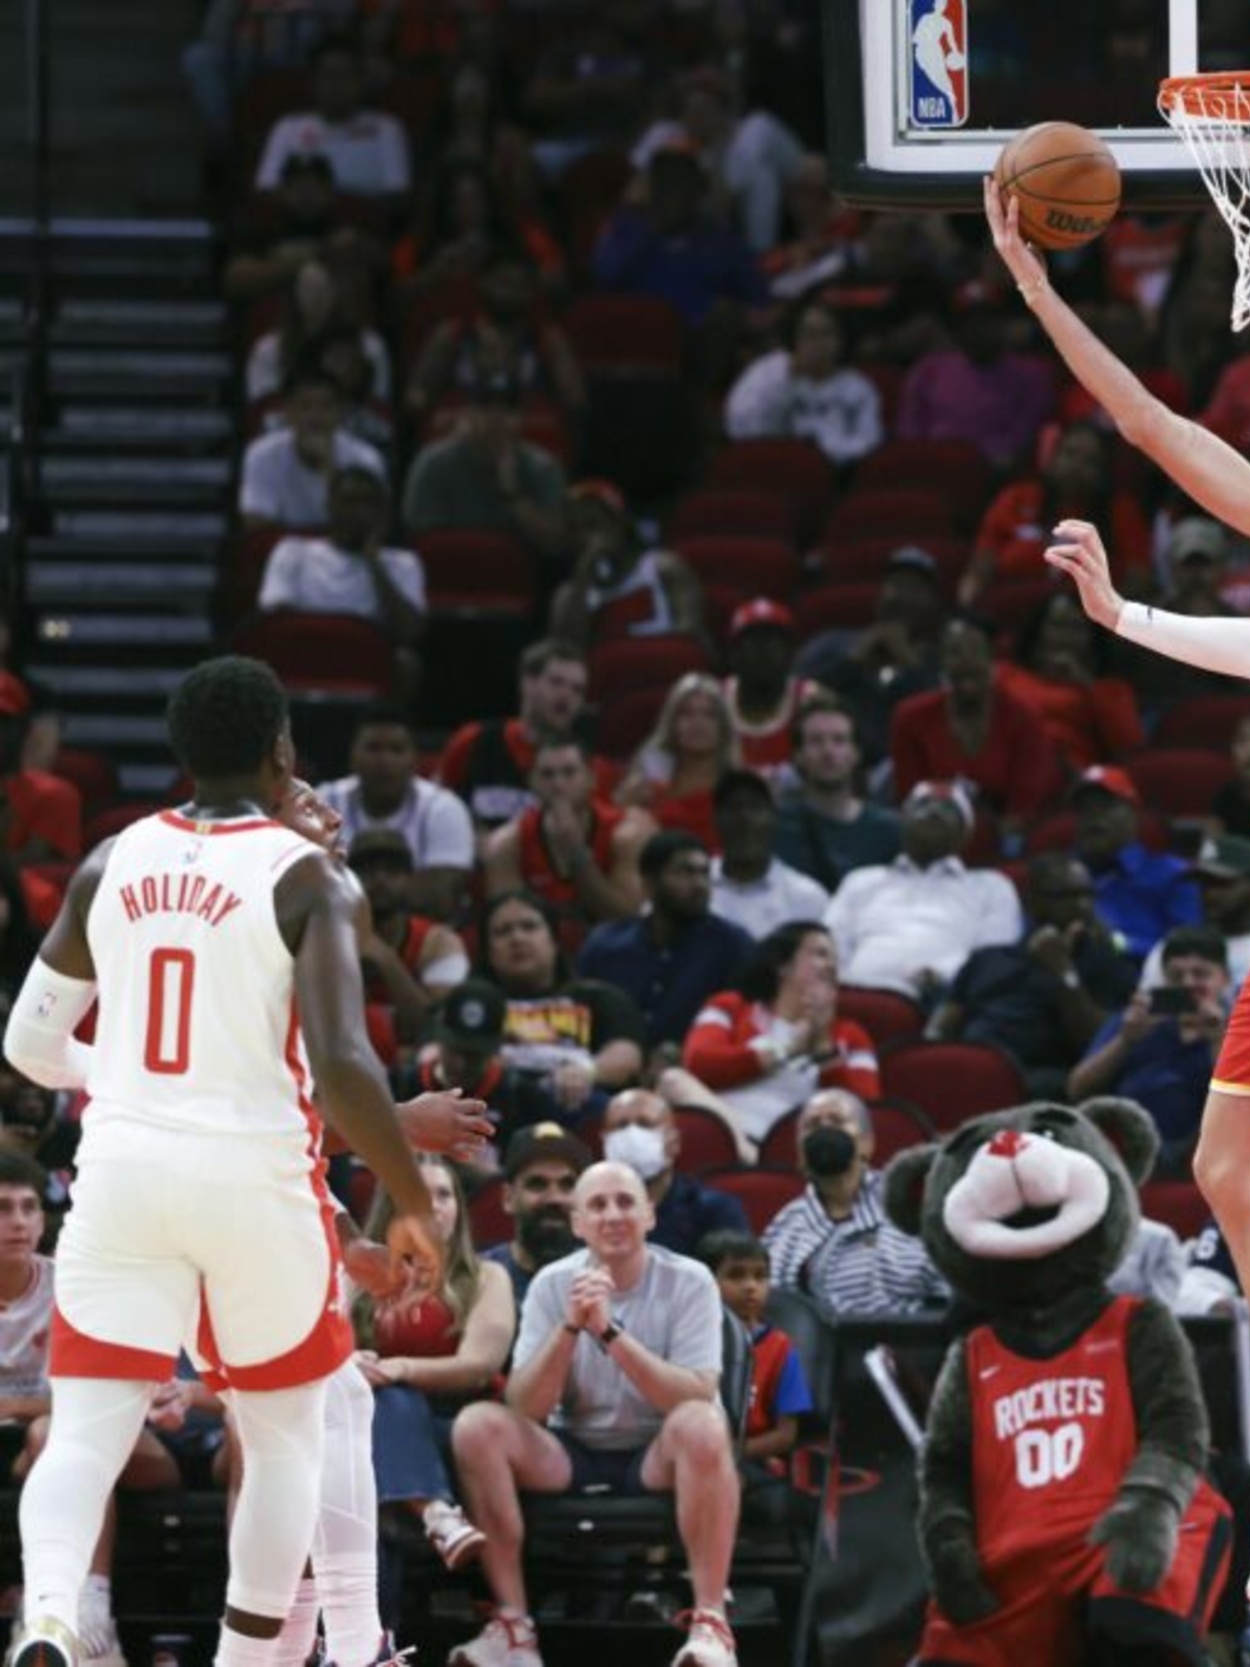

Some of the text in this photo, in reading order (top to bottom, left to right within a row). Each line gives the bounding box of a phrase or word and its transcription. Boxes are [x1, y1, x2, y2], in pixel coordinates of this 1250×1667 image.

[918, 97, 946, 118] NBA
[120, 873, 242, 927] HOLIDAY
[144, 947, 195, 1074] 0
[995, 1376, 1105, 1440] ROCKETS
[1015, 1422, 1084, 1489] 00
